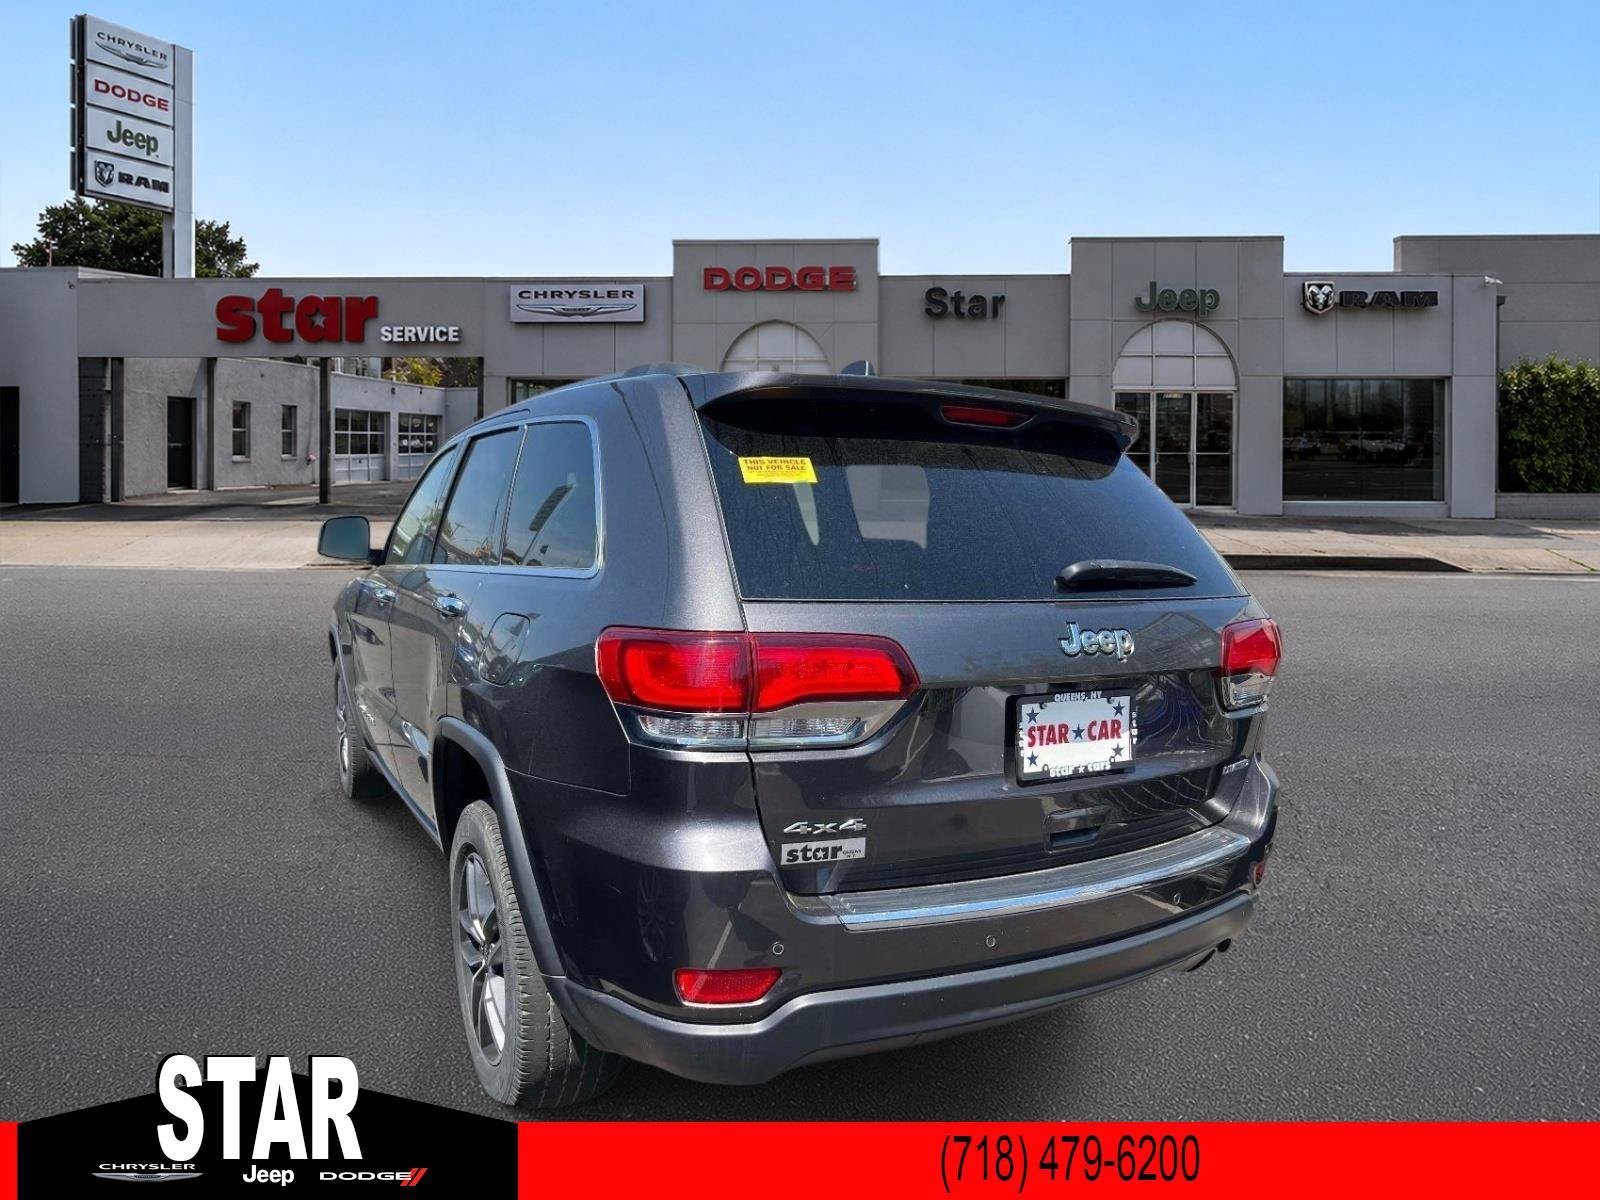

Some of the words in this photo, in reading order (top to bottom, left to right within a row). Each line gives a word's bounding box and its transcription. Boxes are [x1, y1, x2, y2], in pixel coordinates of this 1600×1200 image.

[96, 31, 168, 61] CHRYSLER
[94, 79, 169, 112] DODGE
[106, 120, 159, 156] Jeep
[118, 171, 170, 193] RAM
[703, 266, 858, 292] DODGE
[517, 289, 636, 300] CHRYSLER
[924, 286, 1007, 320] Star
[1134, 281, 1220, 317] Jeep
[1338, 289, 1439, 308] RAM
[215, 287, 379, 344] star
[380, 326, 461, 343] SERVICE
[1057, 621, 1136, 662] Jeep
[1027, 722, 1070, 748] STAR
[1087, 719, 1122, 742] CAR
[786, 843, 843, 863] star
